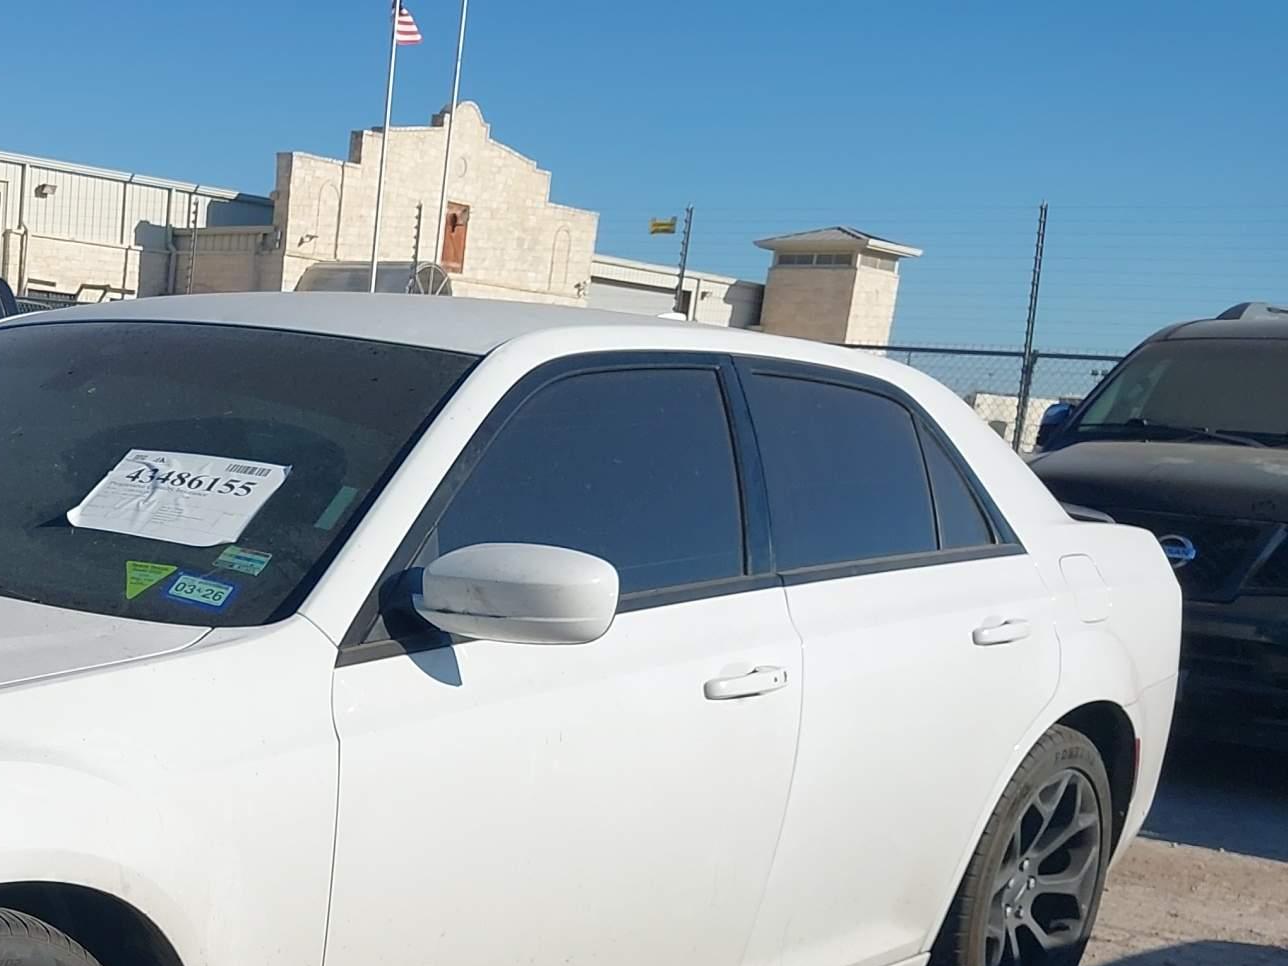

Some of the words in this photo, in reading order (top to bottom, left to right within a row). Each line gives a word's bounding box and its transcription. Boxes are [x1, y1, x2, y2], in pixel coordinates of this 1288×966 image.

[125, 467, 257, 497] 43486155
[174, 581, 196, 595] 03
[201, 587, 225, 602] 26
